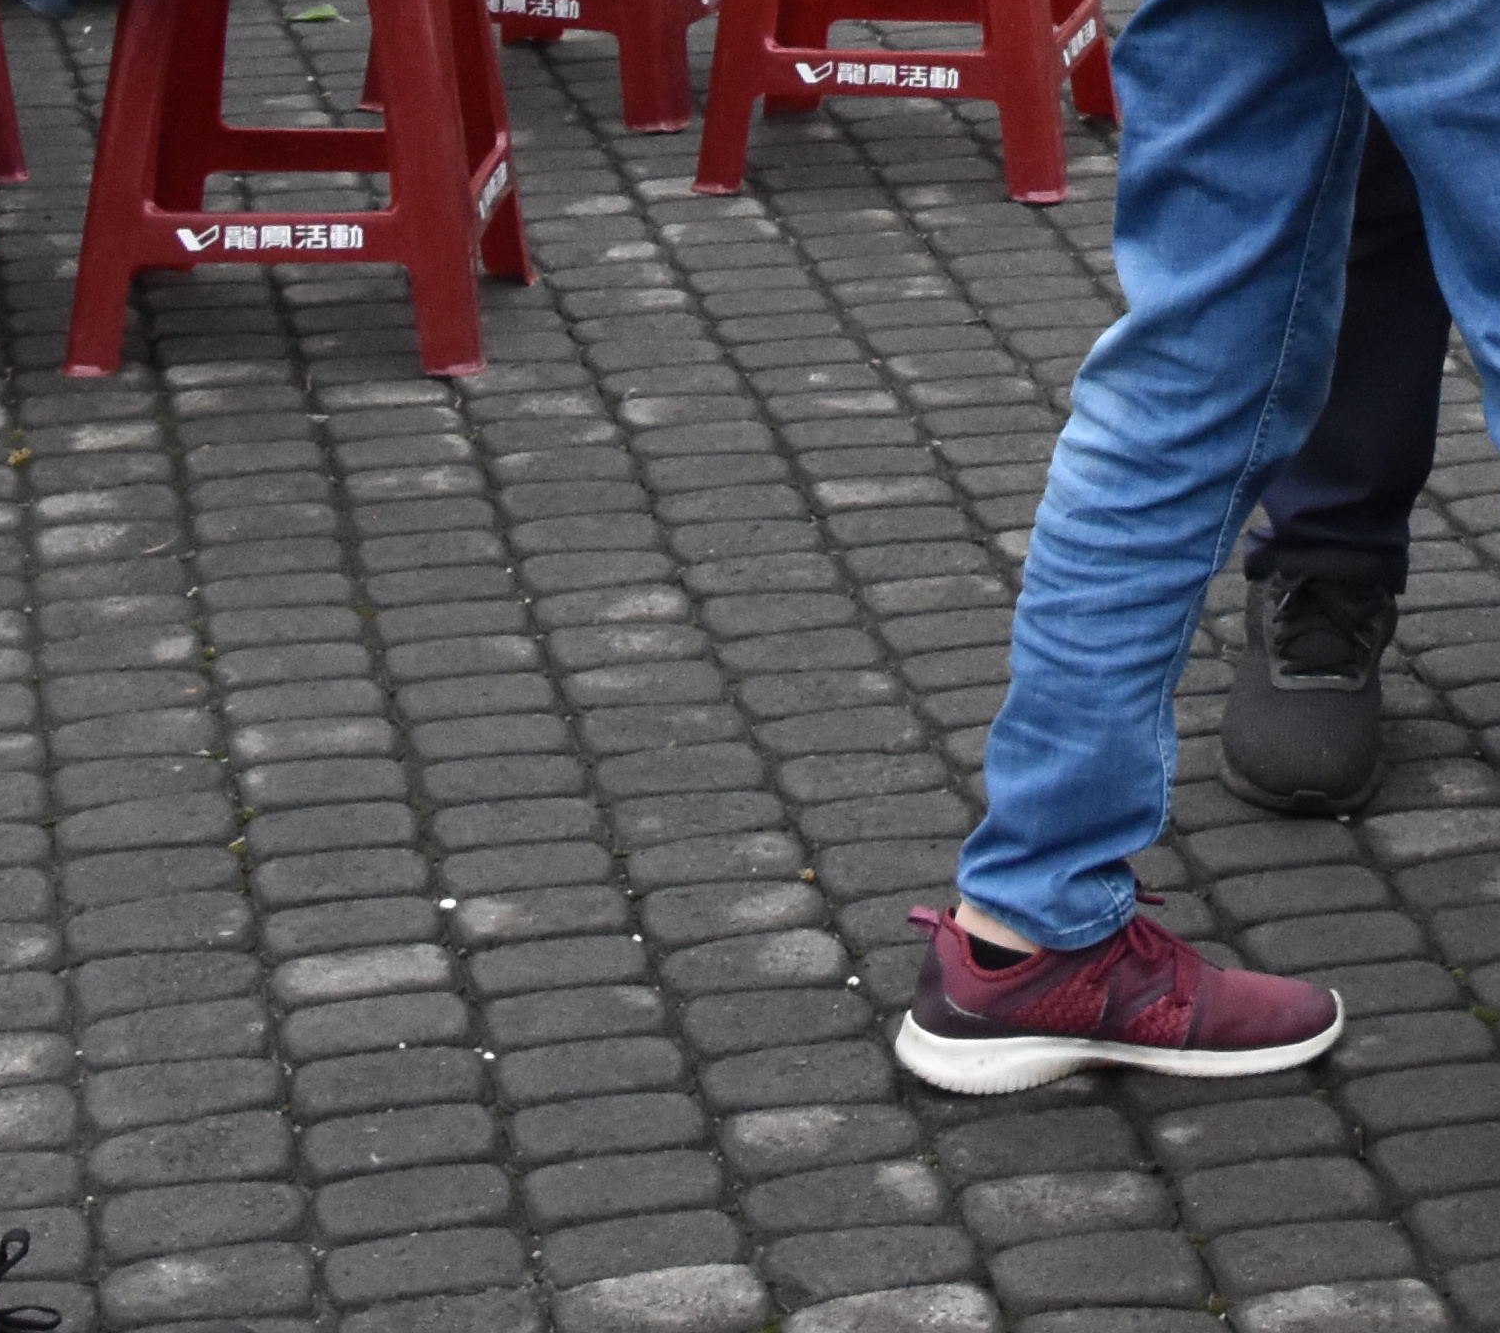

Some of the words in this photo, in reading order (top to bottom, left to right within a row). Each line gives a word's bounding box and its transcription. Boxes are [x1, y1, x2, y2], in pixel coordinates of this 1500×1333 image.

[836, 62, 960, 90] 龍鳳活動
[224, 224, 364, 250] 龍鳳活動
